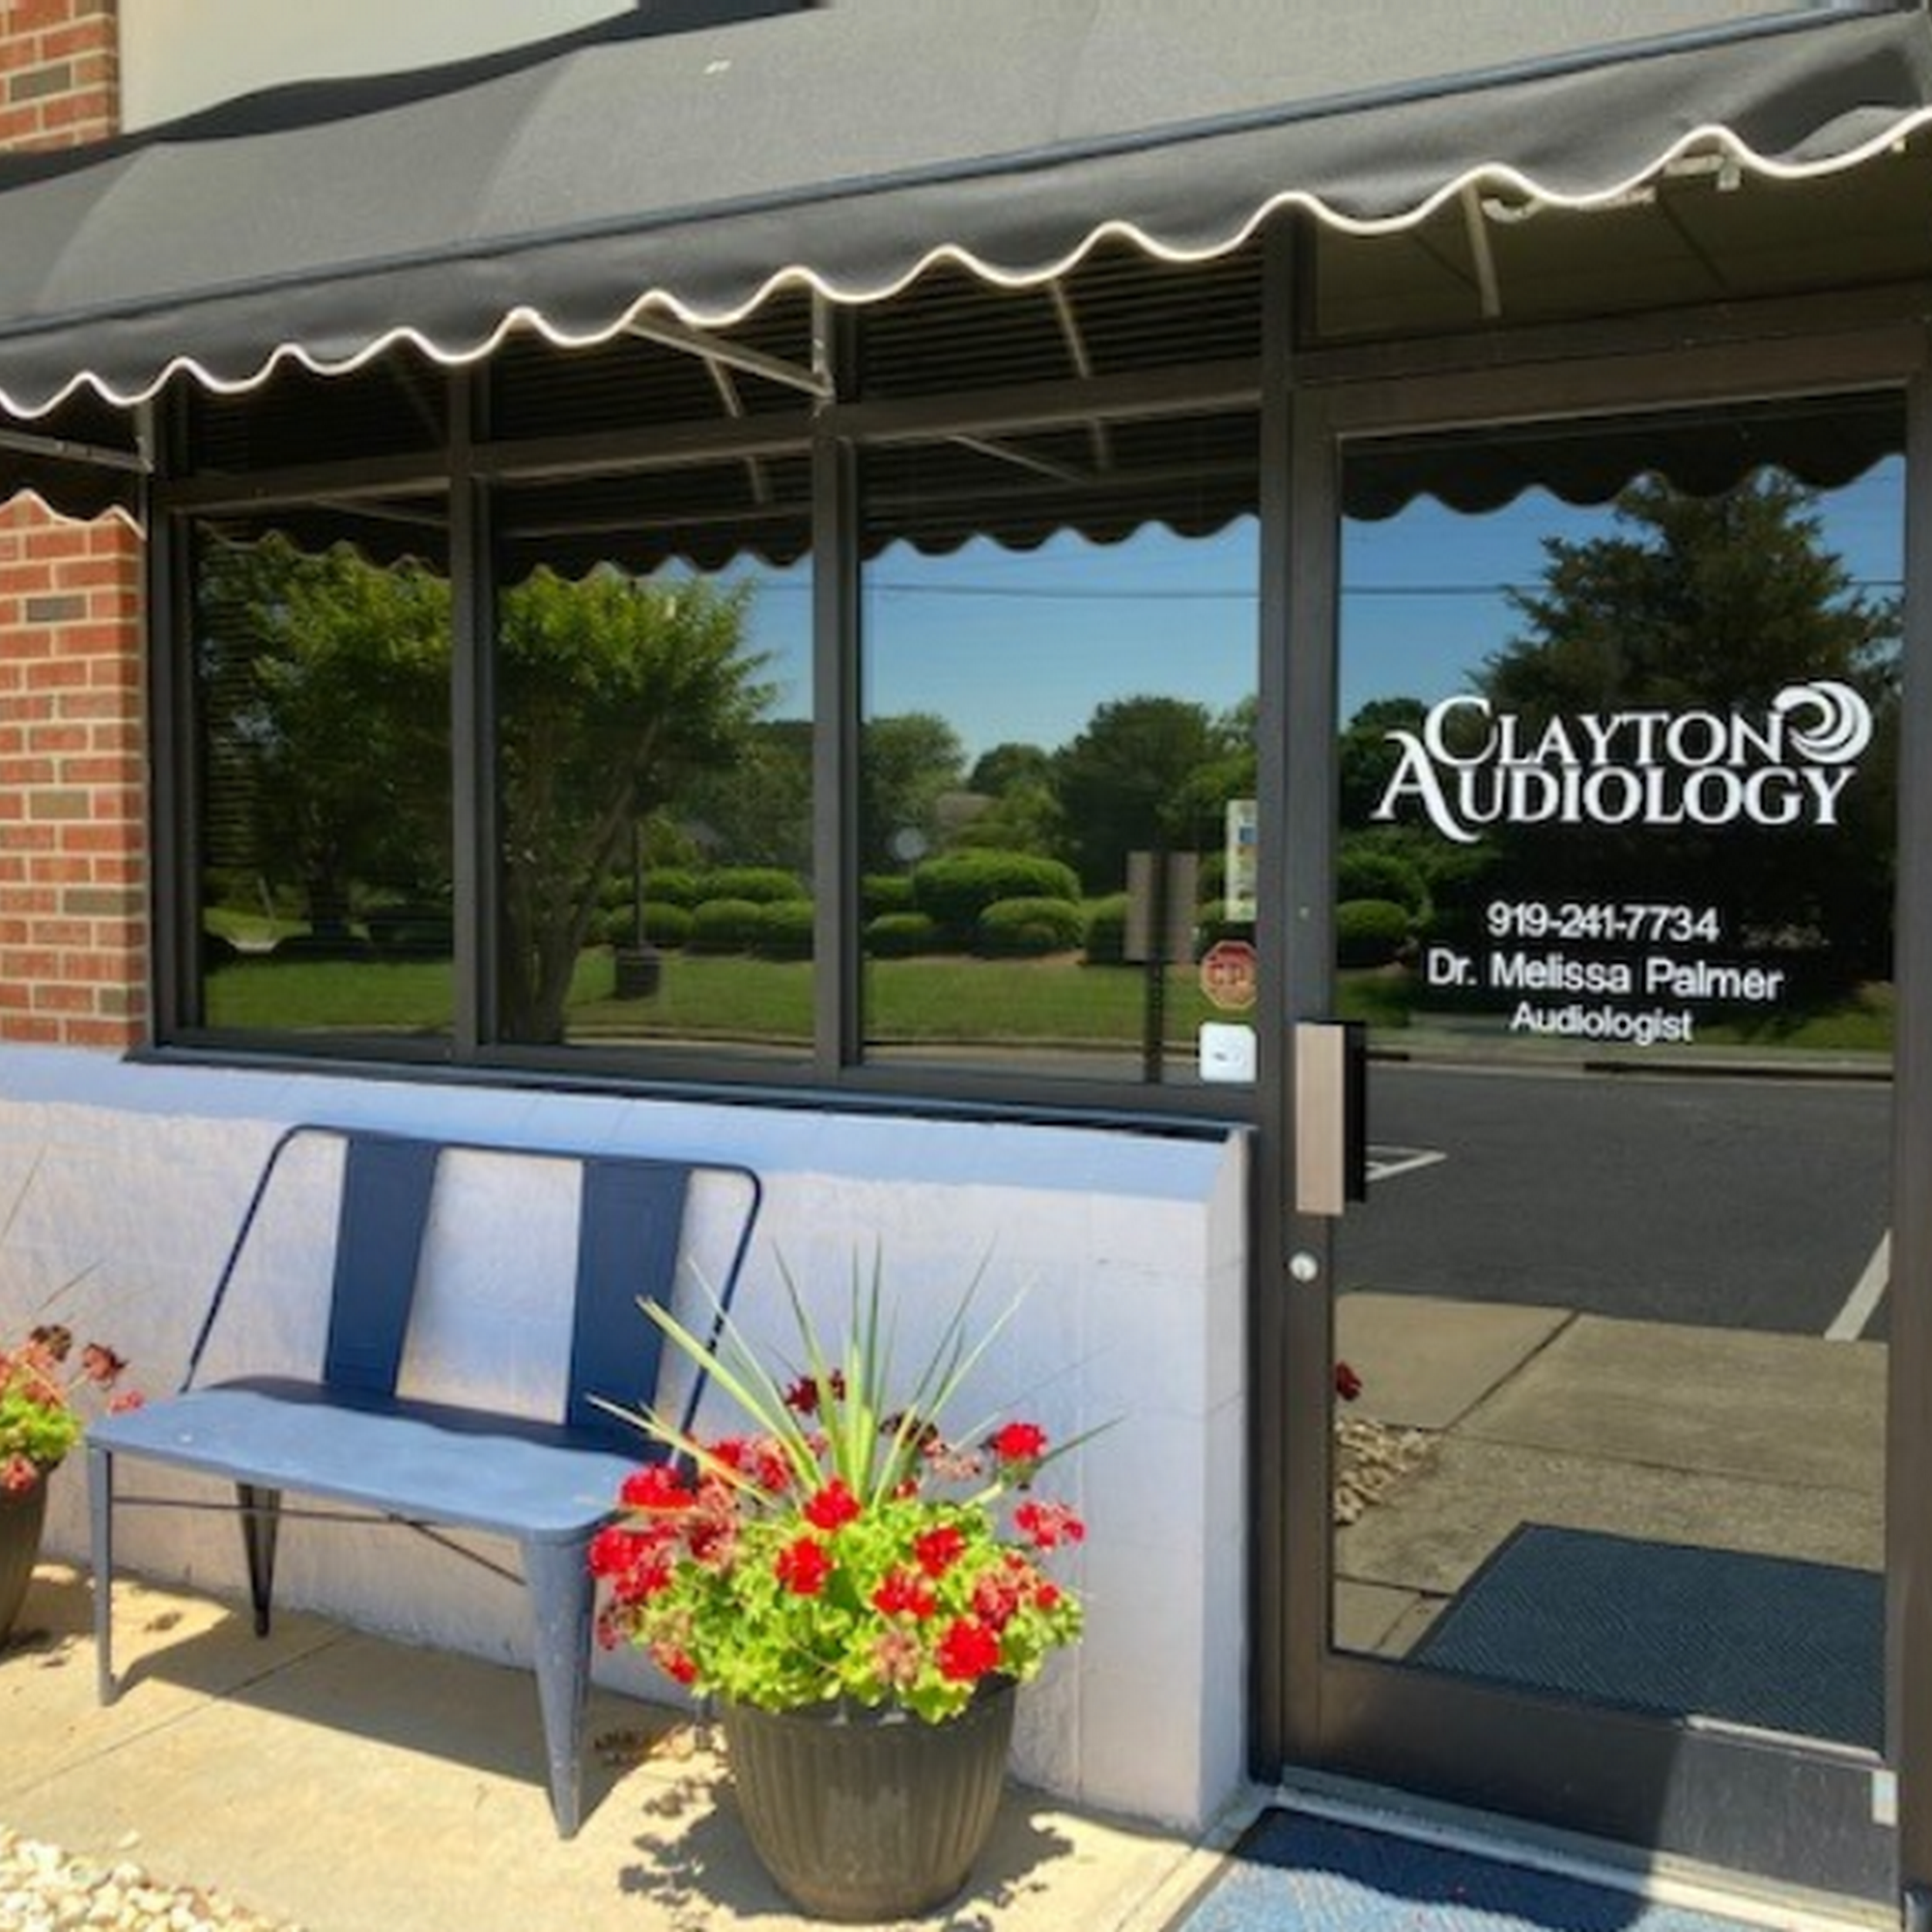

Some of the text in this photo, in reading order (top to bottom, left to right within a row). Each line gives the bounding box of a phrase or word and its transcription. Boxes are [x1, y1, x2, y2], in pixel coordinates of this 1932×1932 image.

[1424, 696, 1782, 766] CLAYTON
[1371, 730, 1856, 842] AUDIOLOGY
[1487, 900, 1719, 943] 919-241-7734
[1427, 949, 1784, 1000] Dr. Melissa Palmer
[1511, 1002, 1692, 1045] Audiologist
